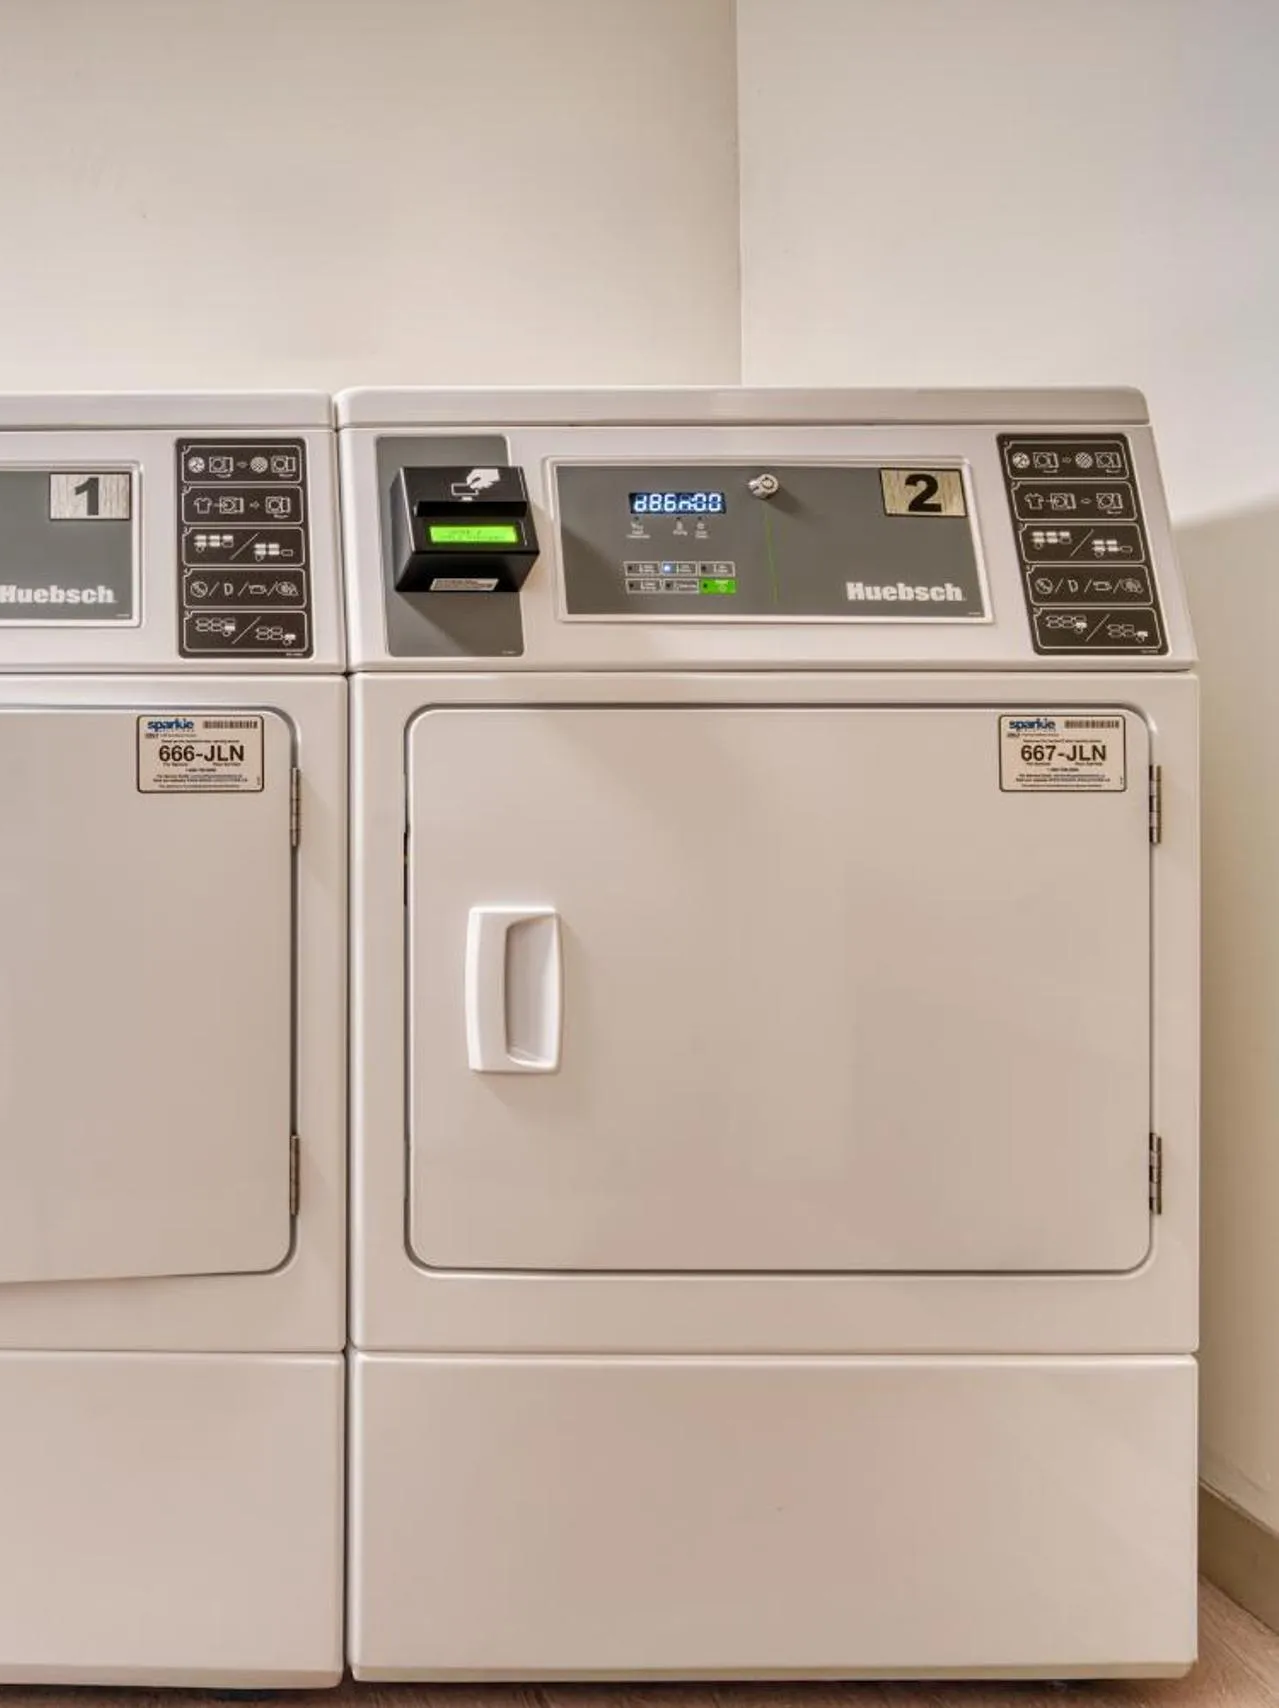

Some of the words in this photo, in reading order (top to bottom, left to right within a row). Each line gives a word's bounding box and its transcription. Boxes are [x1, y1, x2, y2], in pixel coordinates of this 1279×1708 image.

[74, 477, 100, 516] 1
[904, 474, 942, 513] 2
[0, 584, 115, 604] Huebsch
[845, 582, 963, 601] Huebsch
[159, 745, 244, 761] 666-JLN
[1021, 745, 1106, 761] 667-JLN
